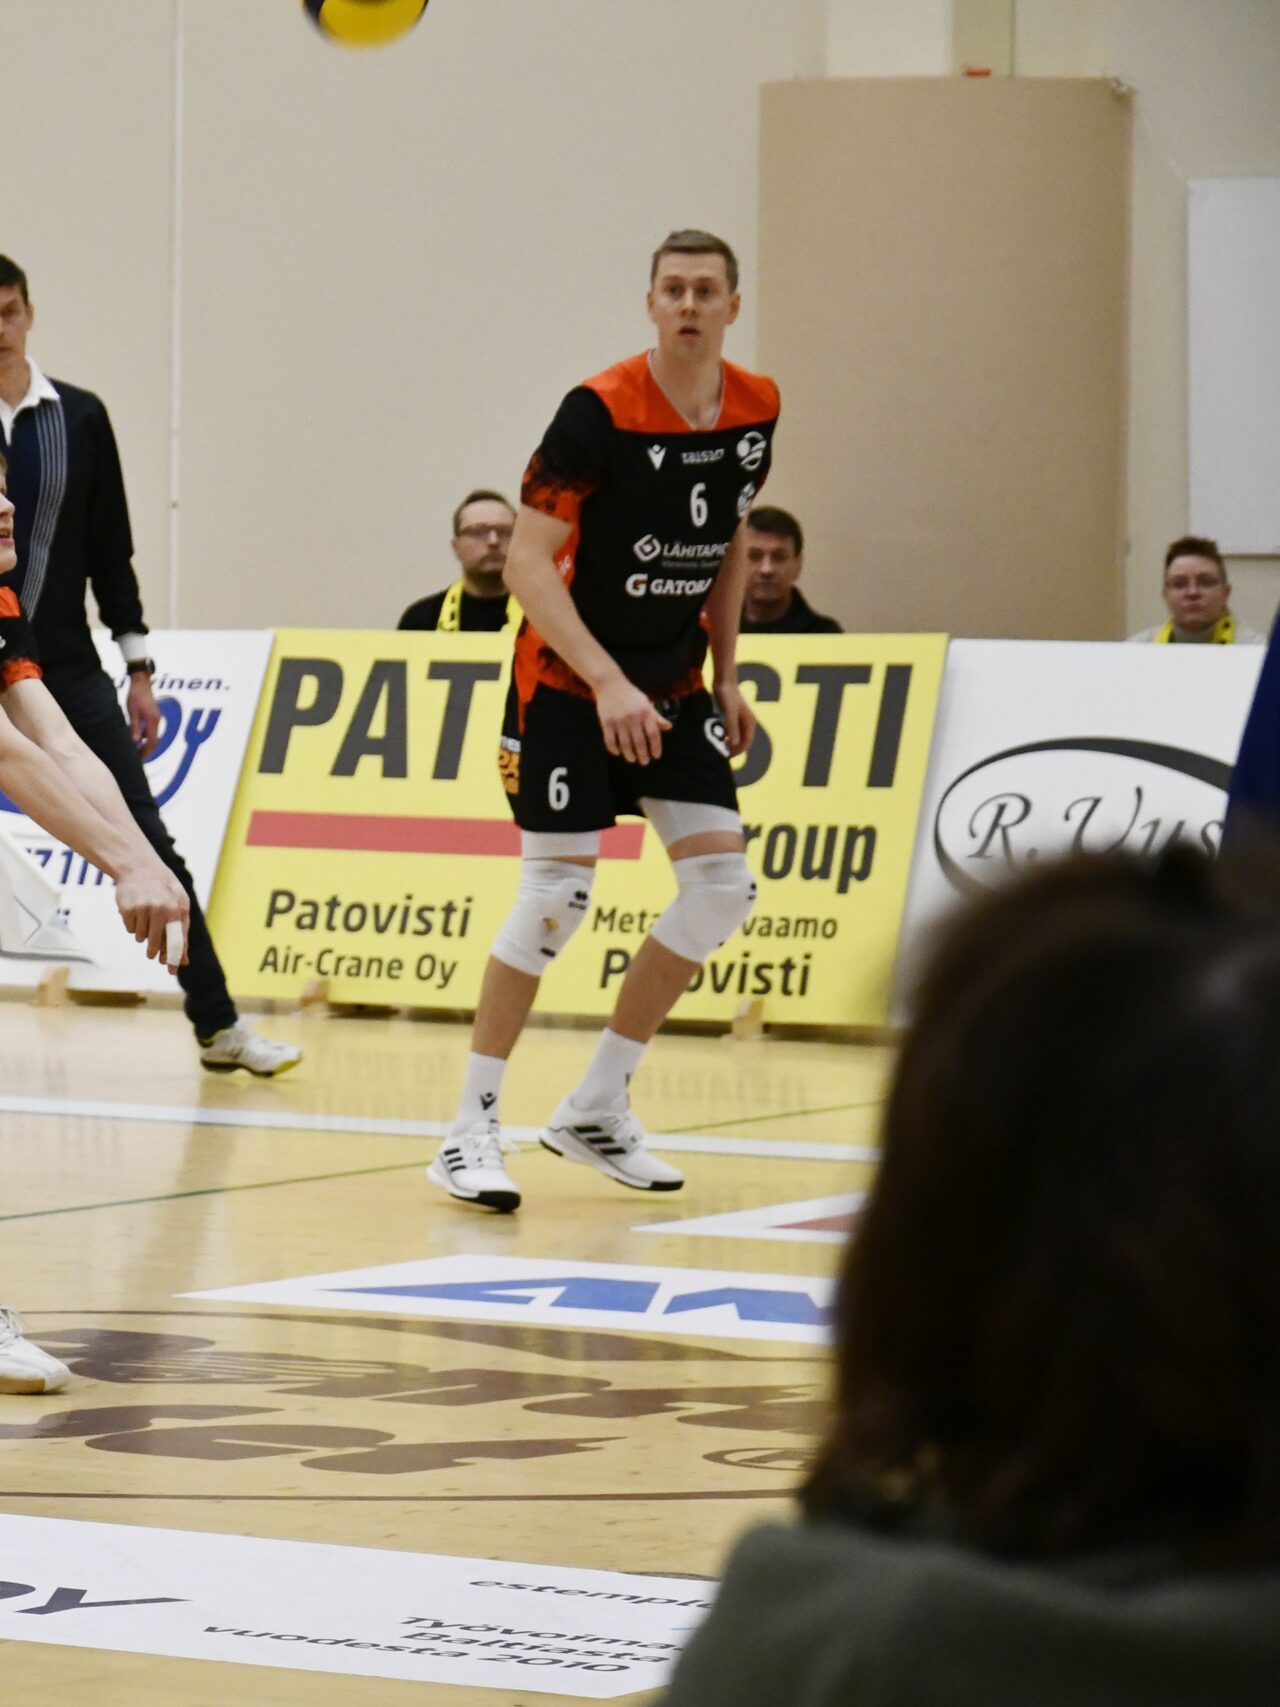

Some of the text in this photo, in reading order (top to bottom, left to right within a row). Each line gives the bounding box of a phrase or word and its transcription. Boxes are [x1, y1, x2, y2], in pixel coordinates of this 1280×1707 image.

[690, 482, 708, 527] 6
[548, 766, 570, 811] 6
[265, 889, 473, 938] Patovisti
[259, 946, 457, 989] Air-Crane Oy
[203, 1626, 631, 1672] vuodesta 2010
[401, 1616, 686, 1651] Työvoima
[401, 1632, 671, 1662] Baltiasta
